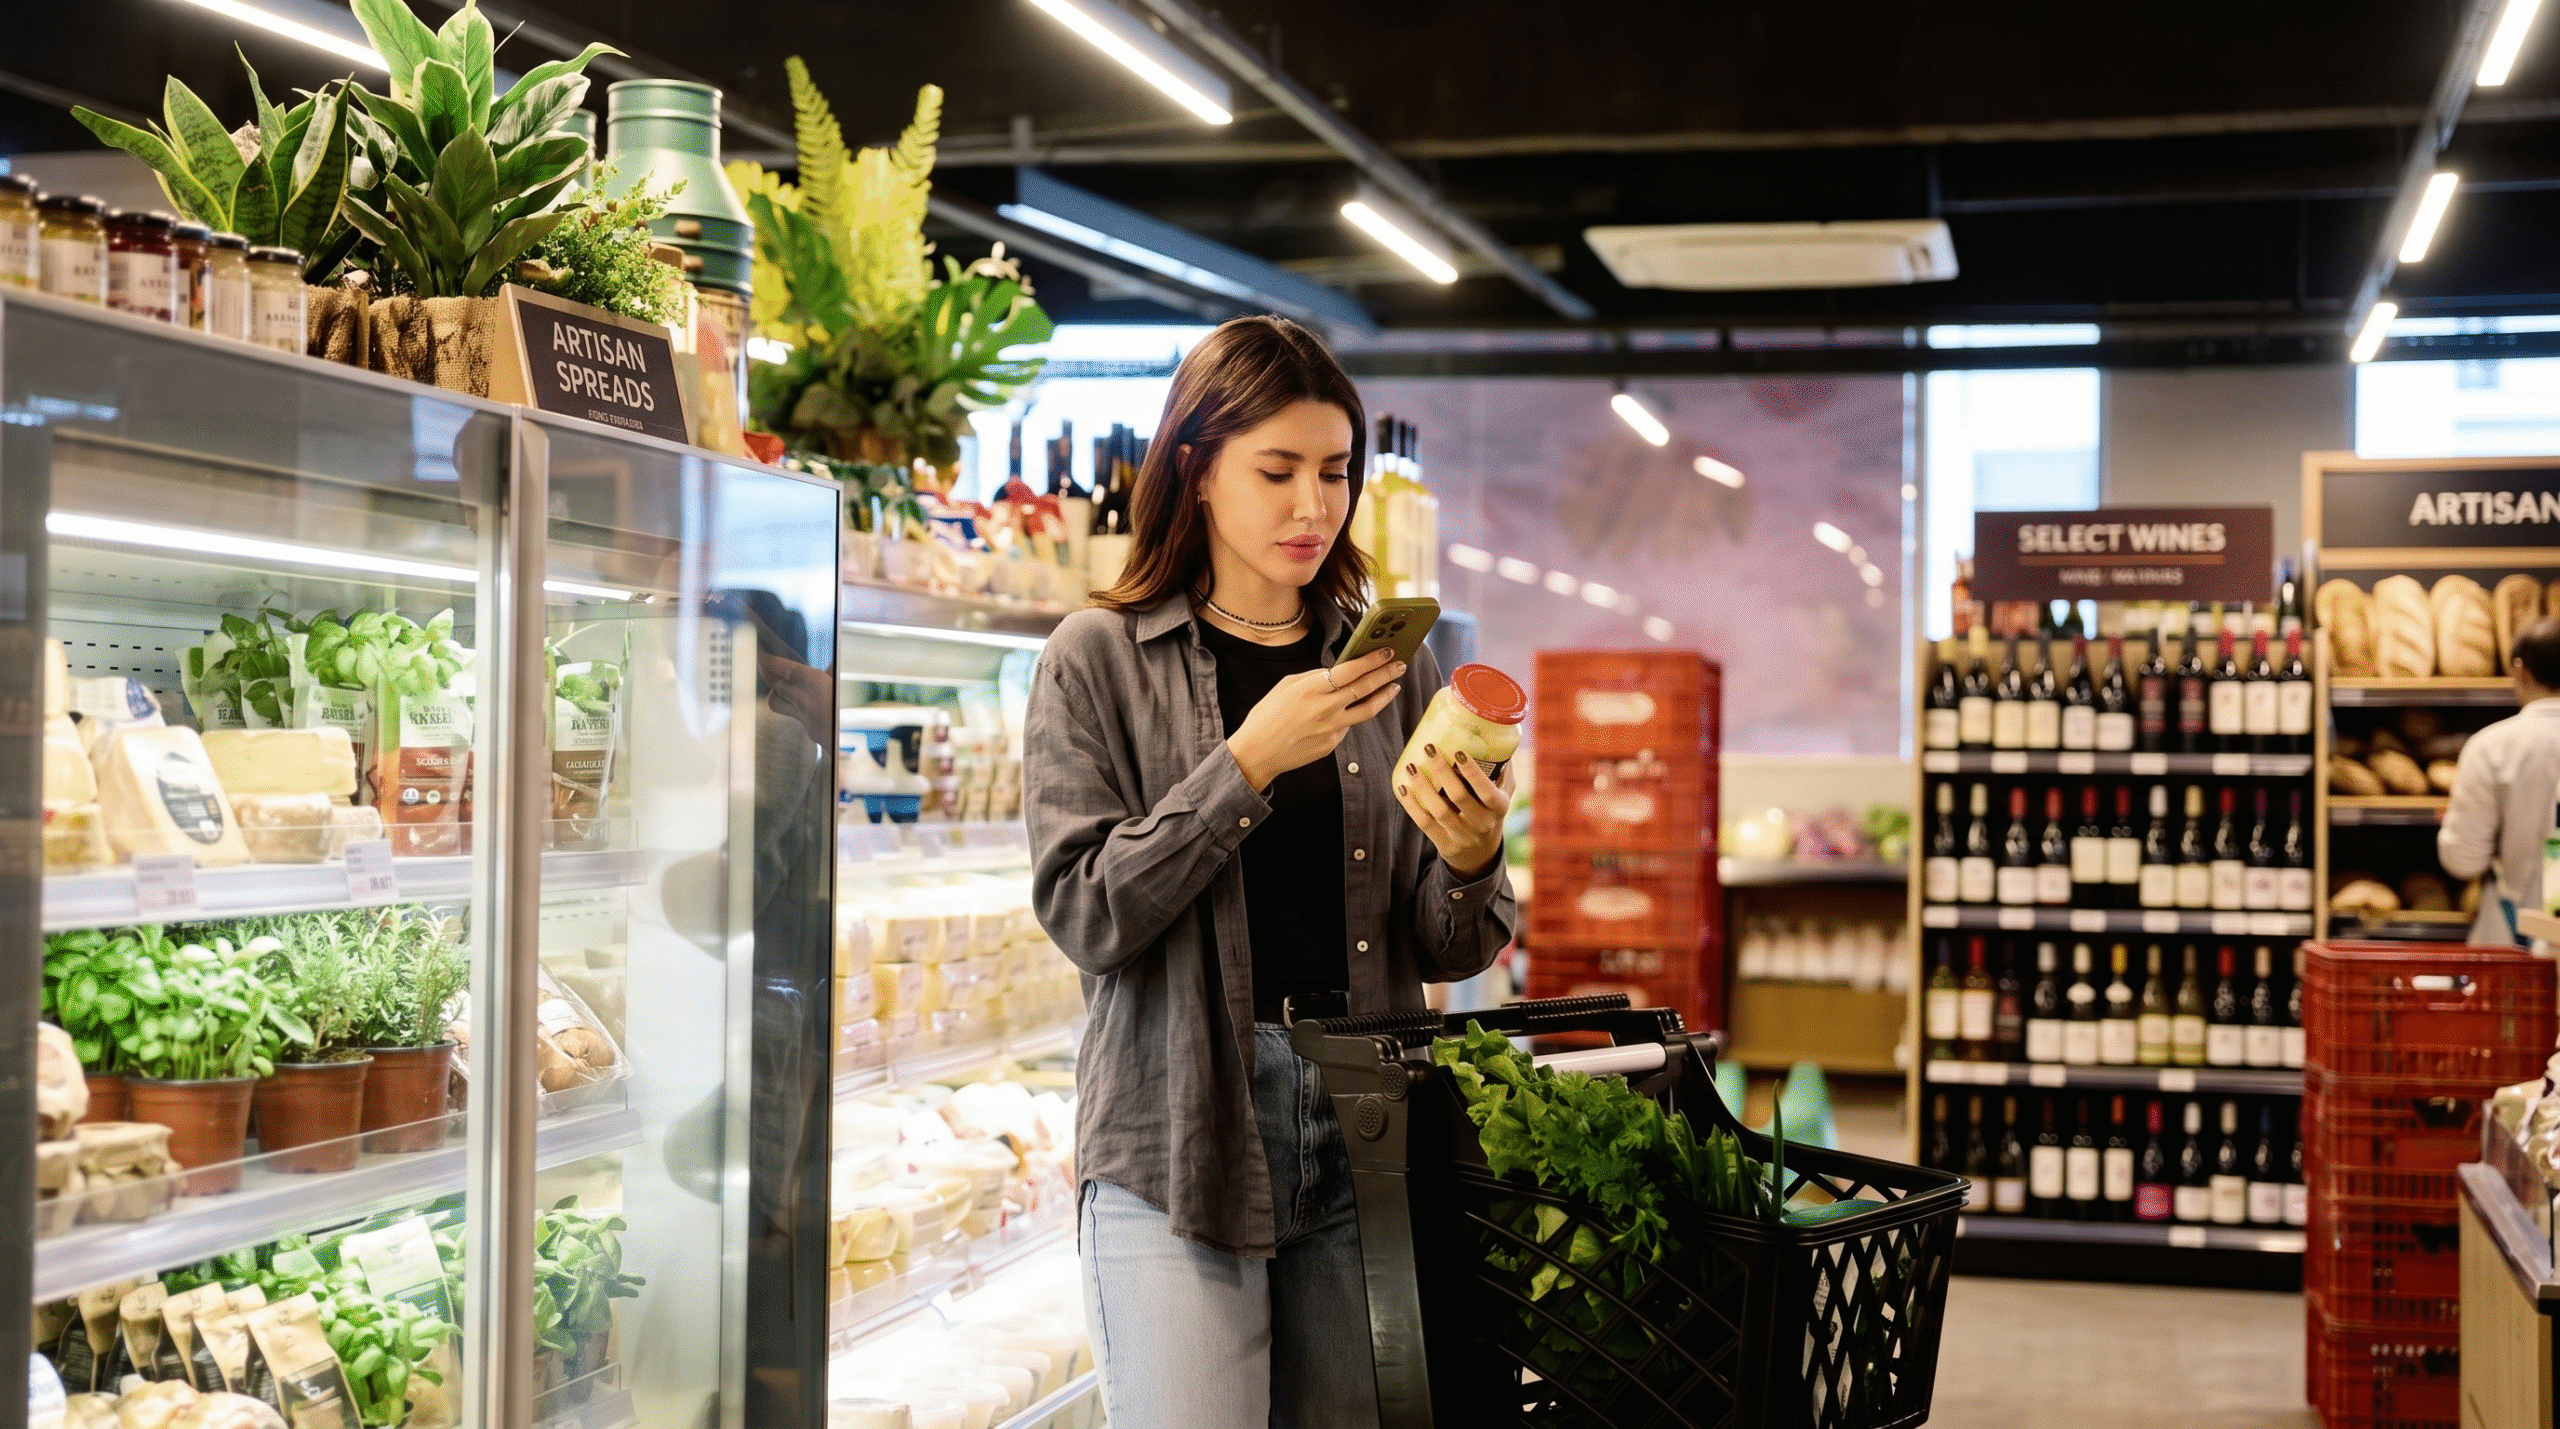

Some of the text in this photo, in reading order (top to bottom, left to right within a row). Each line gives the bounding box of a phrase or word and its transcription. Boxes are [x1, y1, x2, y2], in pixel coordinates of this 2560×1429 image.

[552, 321, 647, 373] ARTISAN
[556, 360, 655, 412] SPREADS
[2408, 491, 2560, 525] ARTISAN
[2018, 522, 2227, 553] SELECT WINES
